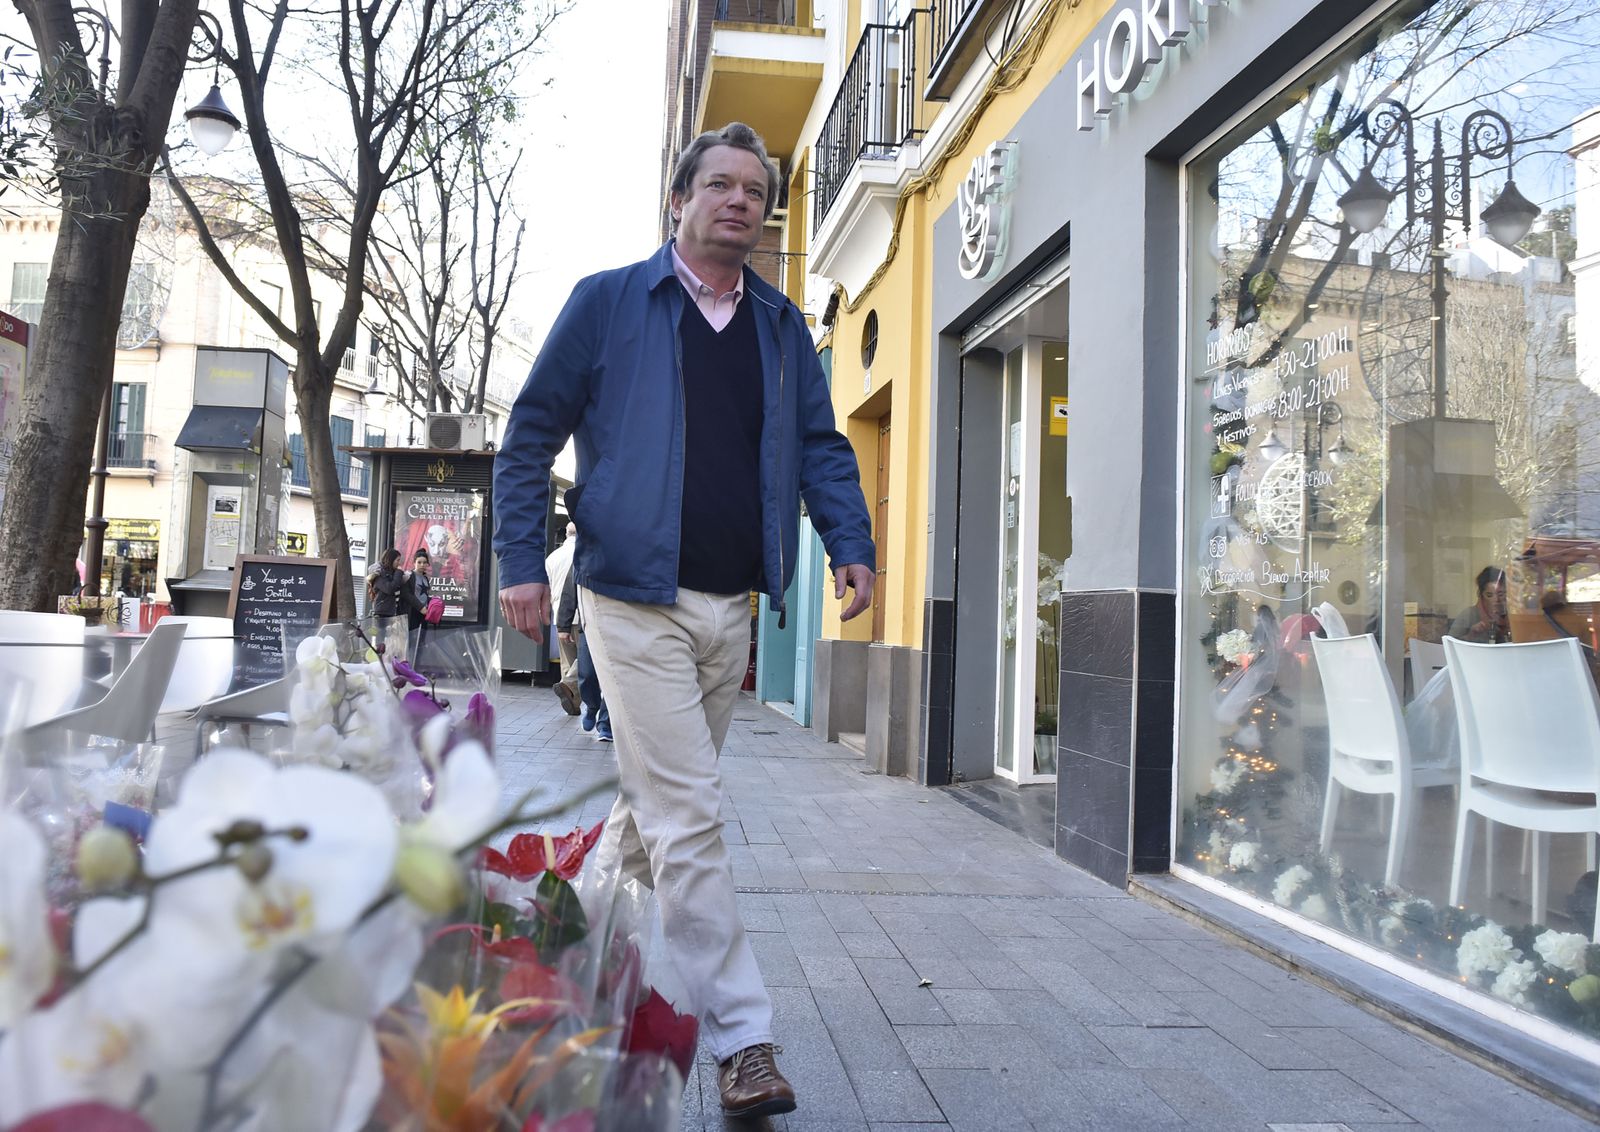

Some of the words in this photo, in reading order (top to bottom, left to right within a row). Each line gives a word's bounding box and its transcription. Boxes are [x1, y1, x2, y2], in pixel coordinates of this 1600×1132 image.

[1207, 324, 1252, 366] HORARIOS
[408, 503, 468, 520] CABARET
[261, 568, 278, 583] Your
[280, 576, 295, 587] spot
[265, 586, 293, 598] Sevilla
